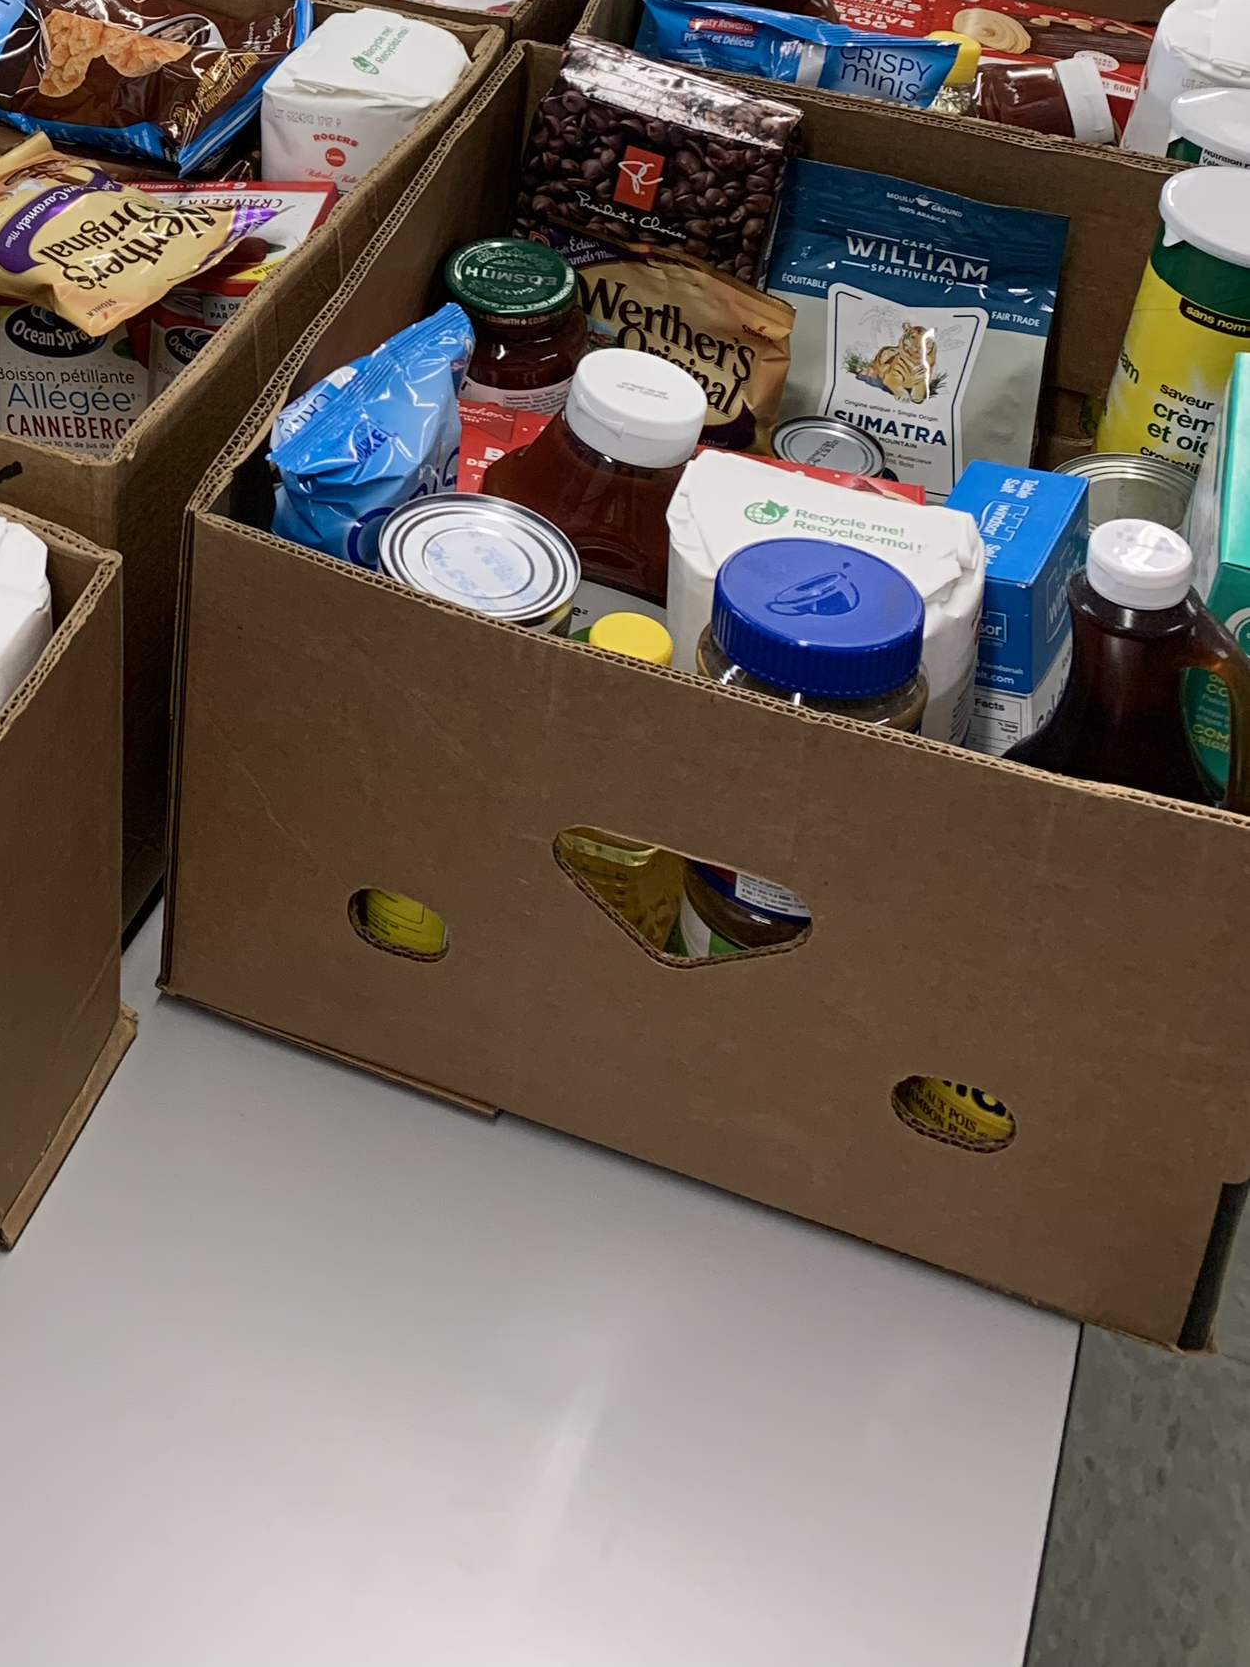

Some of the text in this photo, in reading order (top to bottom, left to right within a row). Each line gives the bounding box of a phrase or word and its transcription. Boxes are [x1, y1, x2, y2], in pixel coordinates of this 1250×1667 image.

[719, 19, 754, 33] Rewards
[362, 32, 386, 58] Recycle
[723, 33, 755, 49] Délices
[840, 45, 933, 82] CRISPY
[841, 62, 920, 102] minis
[1114, 83, 1132, 94] 600
[313, 133, 359, 149] ROGERS
[16, 189, 71, 234] Caramels
[575, 190, 687, 240] President's Choice
[886, 192, 963, 218] MOULU GROUND
[916, 210, 947, 224] ARABICA
[38, 202, 155, 266] Original
[902, 238, 933, 251] CAFÉ
[63, 206, 216, 291] Werther's
[846, 236, 989, 282] WILLIAM
[781, 272, 828, 290] ÉQUITABLE
[870, 263, 955, 286] SPARTIVENTO
[991, 310, 1040, 327] FAIR TRADE
[1185, 305, 1215, 325] sans
[12, 317, 54, 347] Ocean
[576, 274, 756, 382] Werther's
[60, 365, 135, 385] pétillante
[1160, 382, 1215, 411] saveur
[844, 399, 939, 423] Origine unique Single Origin
[1153, 402, 1214, 435] crèm
[834, 410, 947, 447] SUMATRA
[1147, 421, 1171, 444] et
[878, 436, 918, 450] MOUNTAIN
[897, 453, 933, 466] Audacieux
[999, 478, 1014, 494] Salt
[1017, 479, 1038, 500] Table
[795, 507, 905, 537] Recycle me!
[974, 697, 1005, 712] Facts
[948, 1107, 977, 1133] POIS
